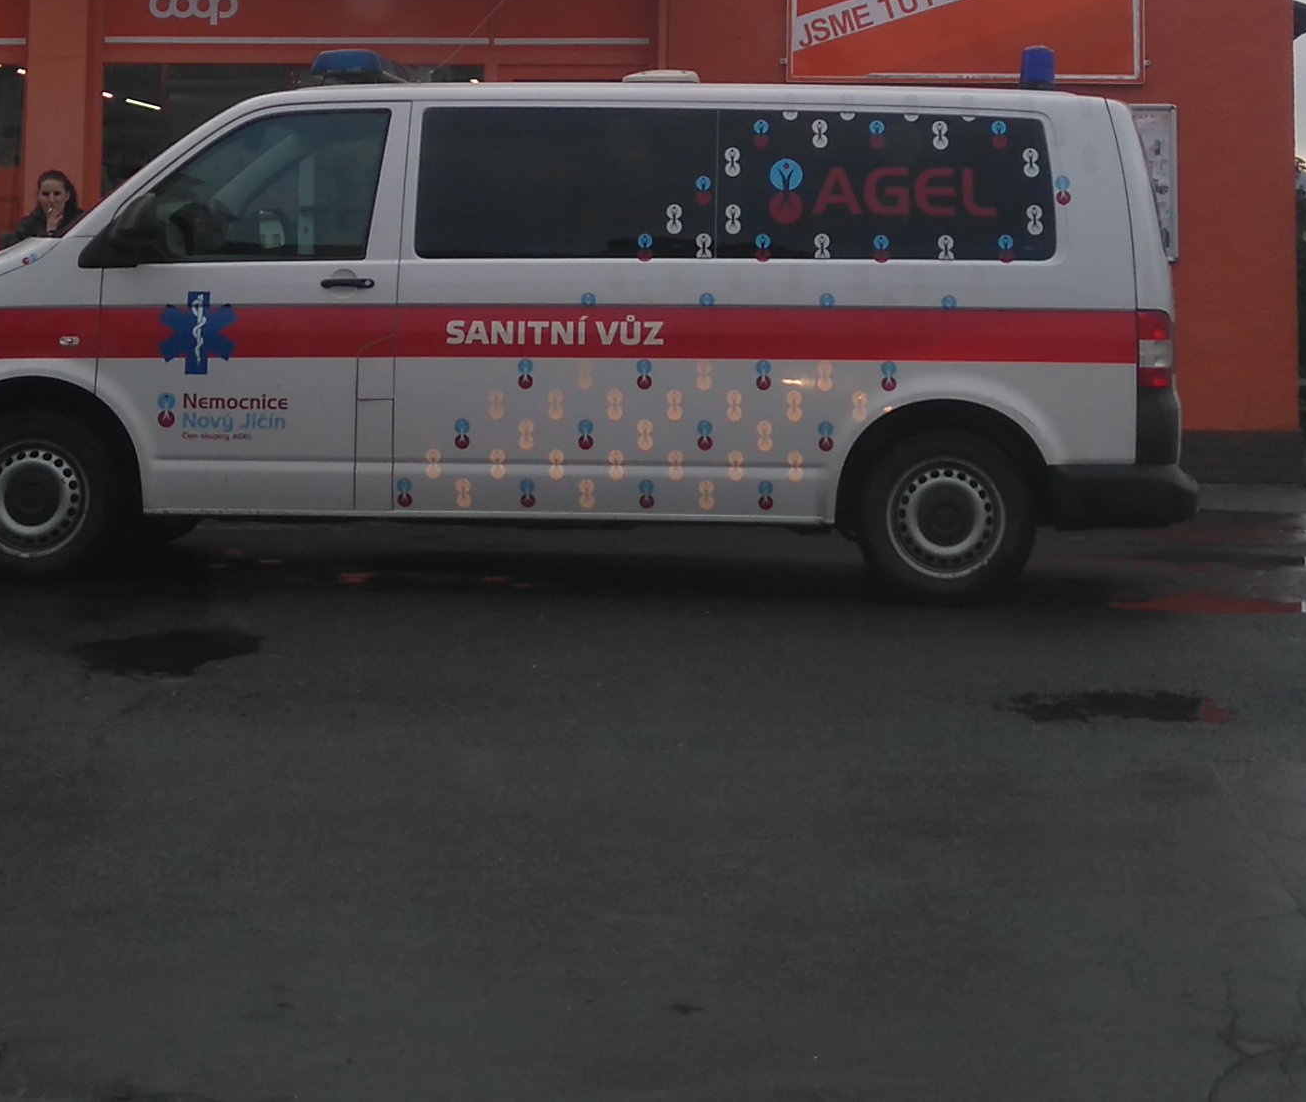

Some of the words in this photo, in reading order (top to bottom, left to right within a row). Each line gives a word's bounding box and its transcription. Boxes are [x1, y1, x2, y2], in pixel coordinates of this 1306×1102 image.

[798, 4, 874, 48] JSME
[812, 166, 998, 217] AGEL
[446, 315, 589, 346] SANITNÍ
[595, 314, 664, 346] VŮZ
[183, 393, 288, 410] Nemocnice
[182, 412, 233, 432] Nový
[239, 412, 286, 429] Jičín
